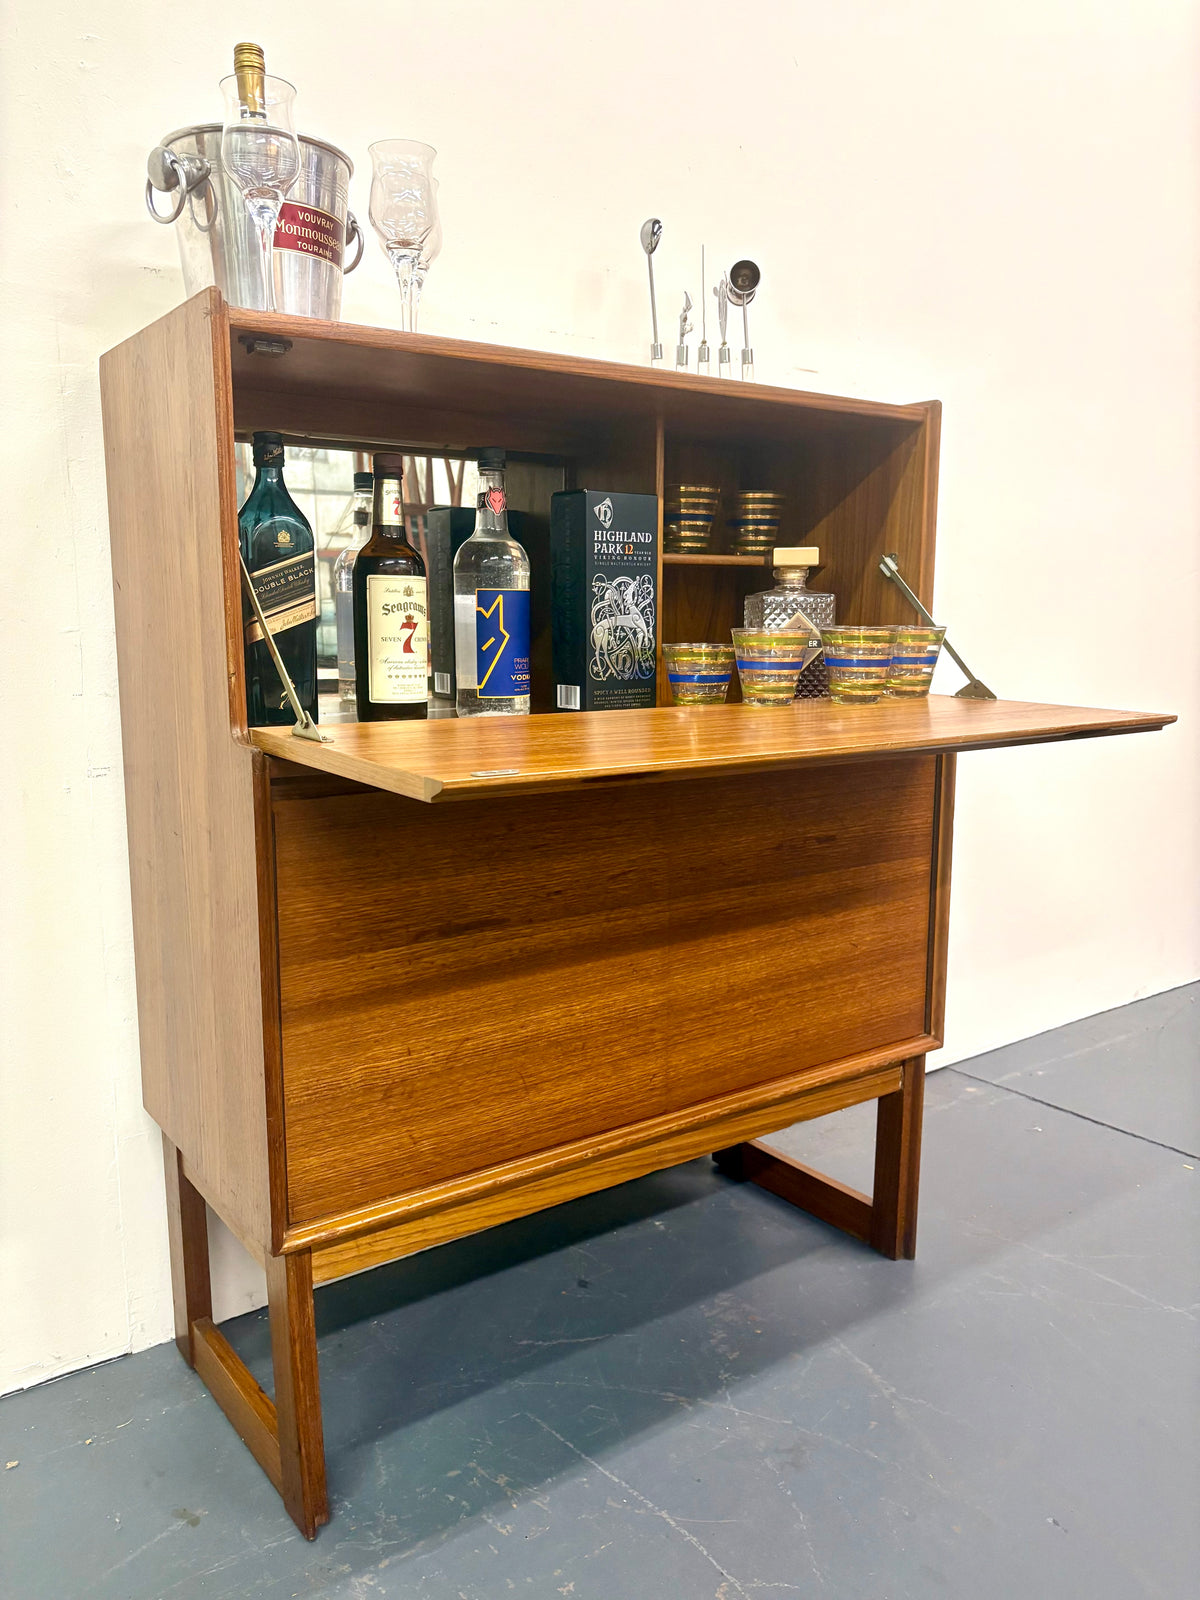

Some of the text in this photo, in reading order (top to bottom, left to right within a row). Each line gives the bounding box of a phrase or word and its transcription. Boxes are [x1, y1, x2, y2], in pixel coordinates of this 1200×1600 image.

[297, 210, 334, 231] VOUVRAY
[297, 241, 333, 259] TOURAINE
[593, 530, 652, 543] HIGHLAND
[593, 542, 623, 555] PARK
[624, 544, 634, 555] 12
[253, 578, 286, 595] DOUBLE
[287, 567, 314, 582] BLACK
[400, 621, 419, 654] 7
